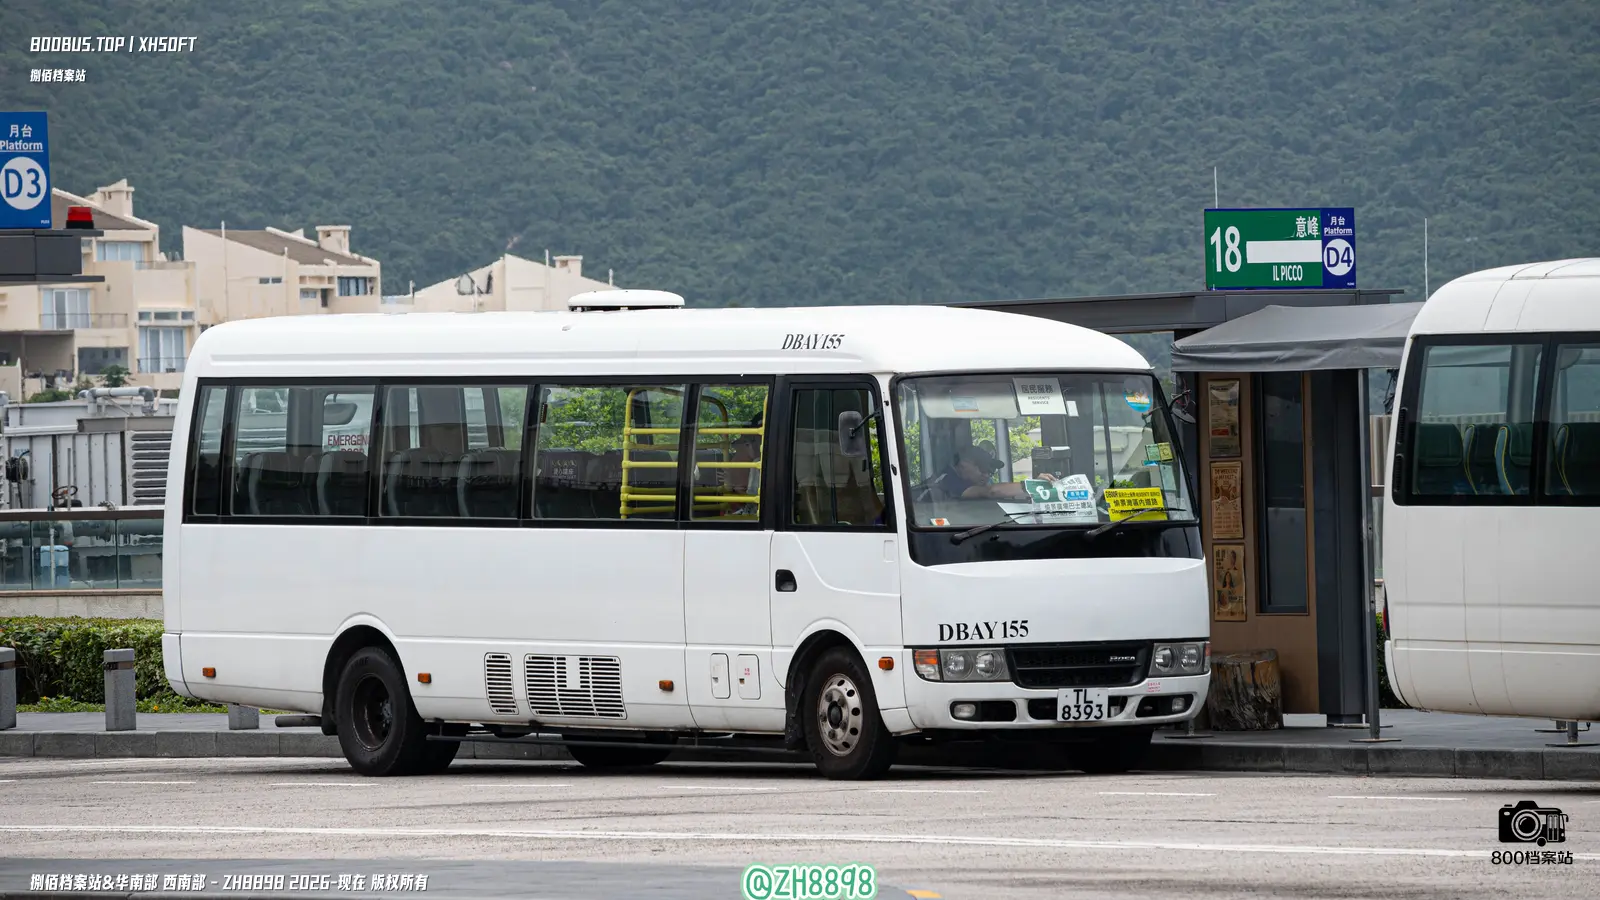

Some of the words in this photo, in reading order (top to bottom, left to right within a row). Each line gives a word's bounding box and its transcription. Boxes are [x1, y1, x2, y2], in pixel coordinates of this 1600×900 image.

[9, 124, 32, 138] 月台
[0, 140, 43, 152] Platform
[4, 167, 41, 199] D3
[1295, 216, 1320, 238] 意峰
[1329, 216, 1346, 226] 月台
[1324, 227, 1353, 236] Platform
[1210, 226, 1242, 273] 18
[1326, 246, 1353, 268] D4
[1273, 265, 1279, 281] IL
[1280, 265, 1303, 281] PICCO
[1072, 688, 1094, 704] TL
[1061, 703, 1104, 721] 8393
